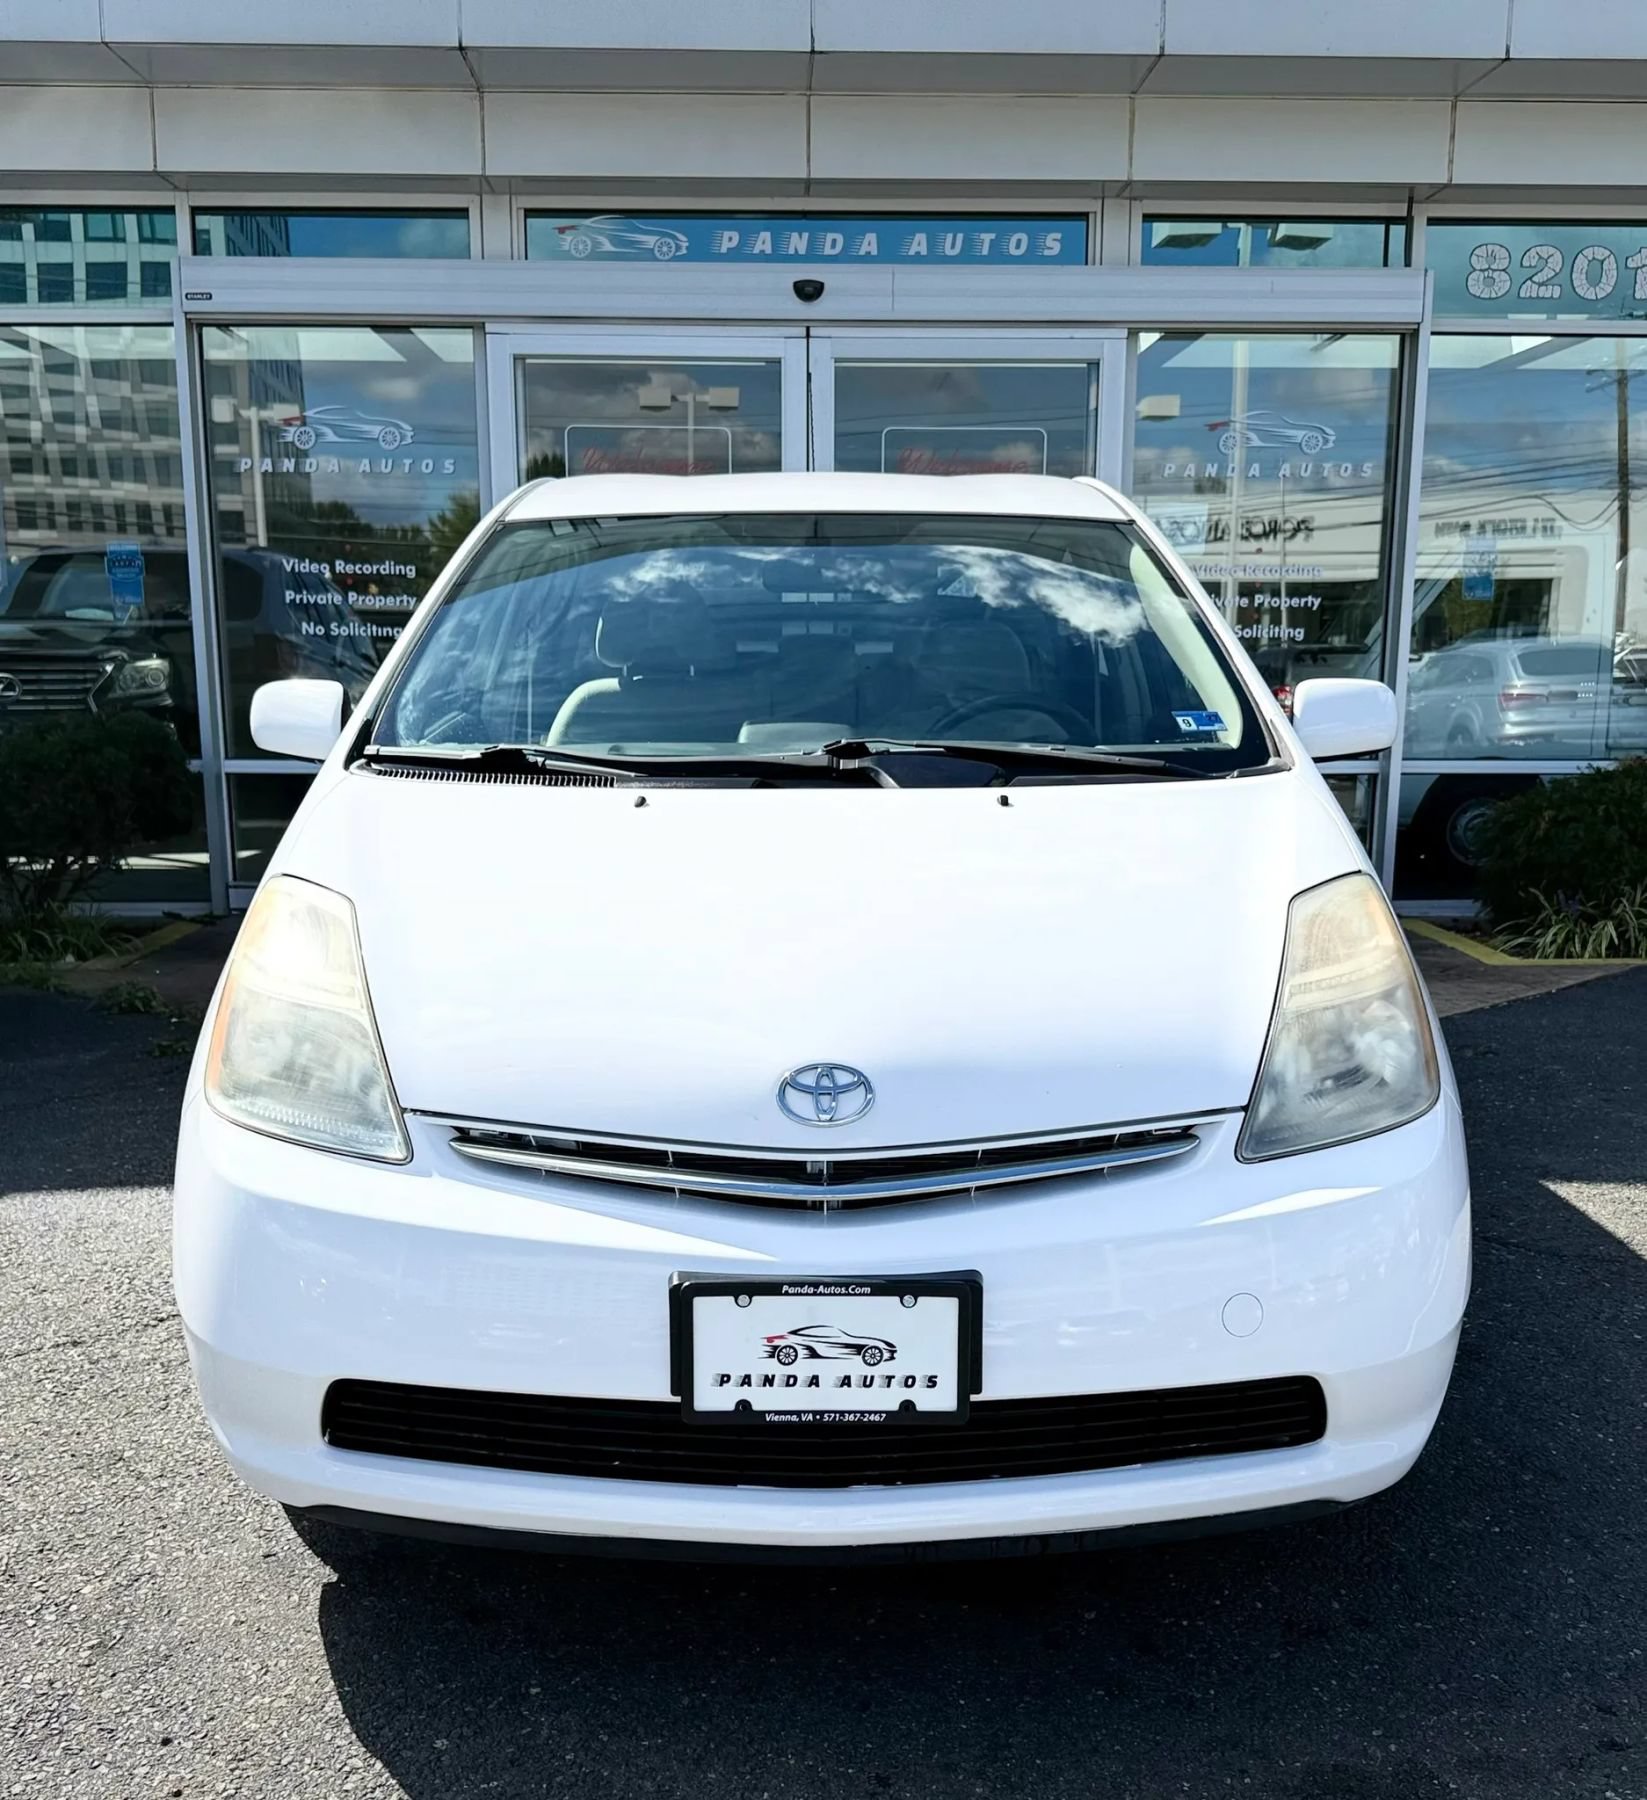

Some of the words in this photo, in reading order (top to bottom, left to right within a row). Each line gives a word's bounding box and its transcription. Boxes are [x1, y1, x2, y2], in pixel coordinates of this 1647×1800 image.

[715, 231, 878, 256] PANDA
[904, 232, 1062, 256] AUTOS
[1466, 243, 1647, 301] 8201
[239, 457, 341, 474] PANDA
[358, 458, 456, 474] AUTOS
[1163, 463, 1260, 478] PANDA
[1278, 462, 1374, 478] AUTOS
[282, 559, 330, 573] Video
[335, 559, 416, 578] Recording
[285, 590, 343, 605] Private
[347, 591, 417, 609] Property
[1211, 594, 1249, 608] ivate
[1253, 594, 1322, 611] Property
[301, 622, 326, 636] No
[330, 622, 402, 640] Soliciting
[1234, 624, 1305, 641] Soliciting
[781, 1285, 871, 1294] Panda-Autos.Com
[715, 1373, 820, 1388] PANDA
[836, 1374, 938, 1389] AUTOS
[765, 1413, 799, 1423] Vienna,
[801, 1413, 814, 1422] VA
[822, 1413, 886, 1422] 571-367-2467
